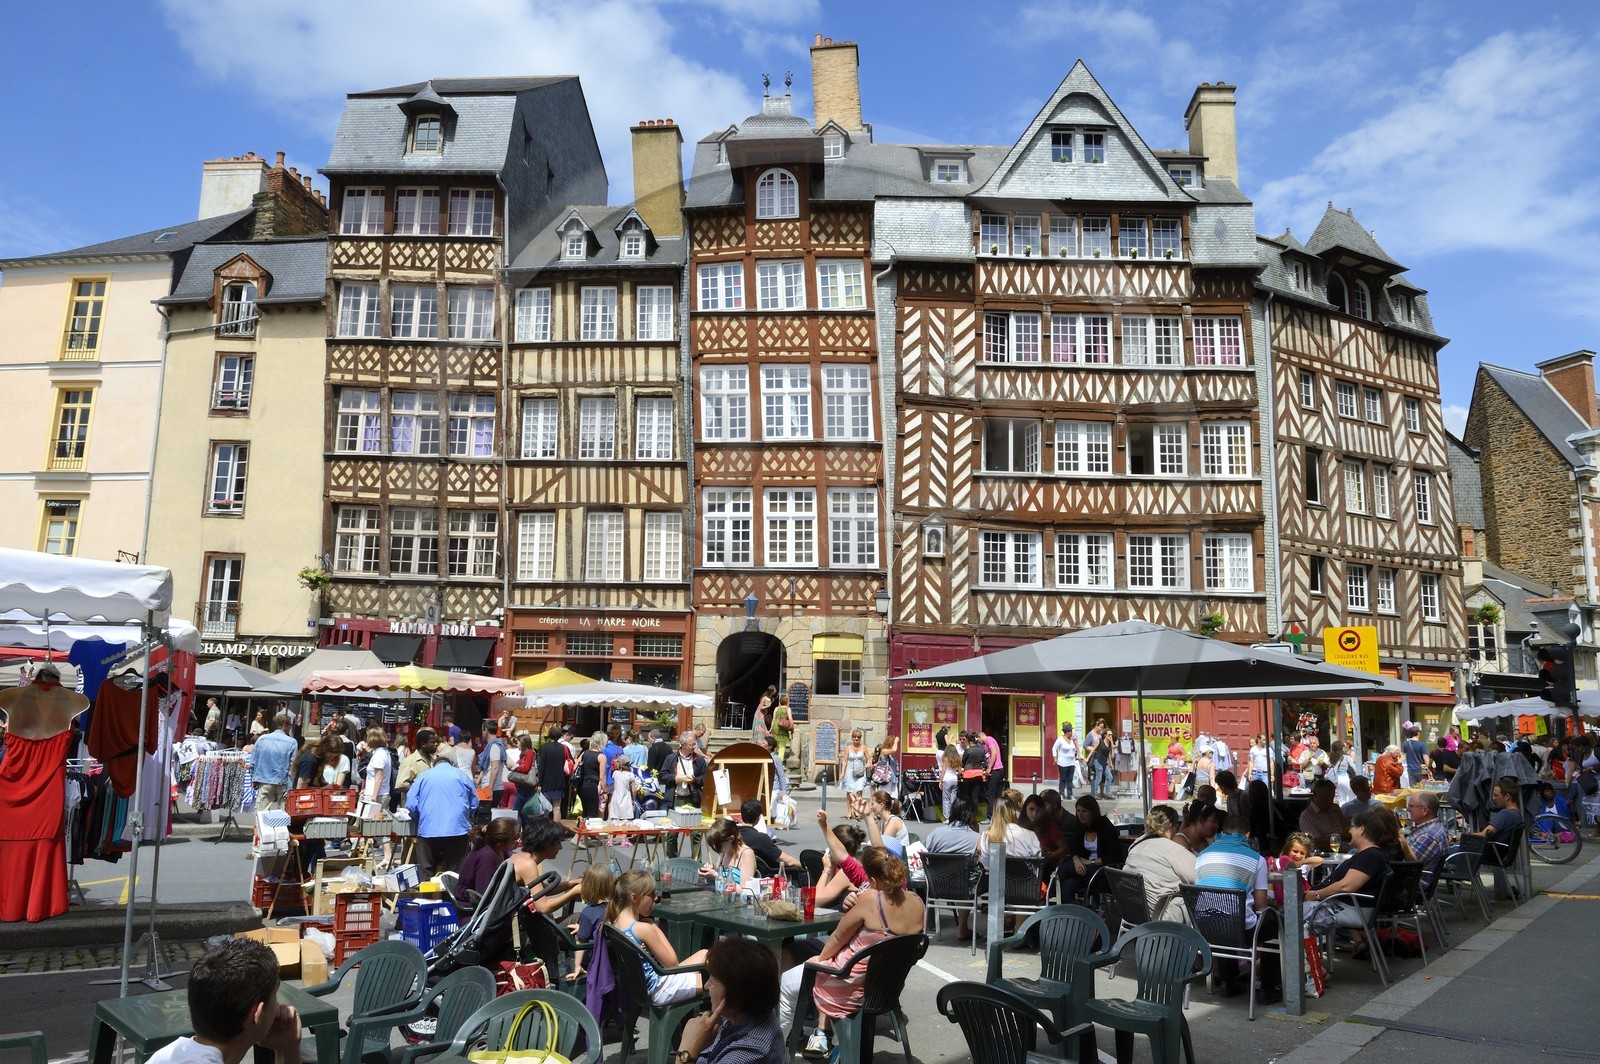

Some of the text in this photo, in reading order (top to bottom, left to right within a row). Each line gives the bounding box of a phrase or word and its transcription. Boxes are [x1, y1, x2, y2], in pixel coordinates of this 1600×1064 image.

[539, 616, 661, 627] crêperie LA HARPE NOIRE
[389, 622, 477, 637] MAMMA ROMA
[1133, 713, 1192, 724] LQUIDATION
